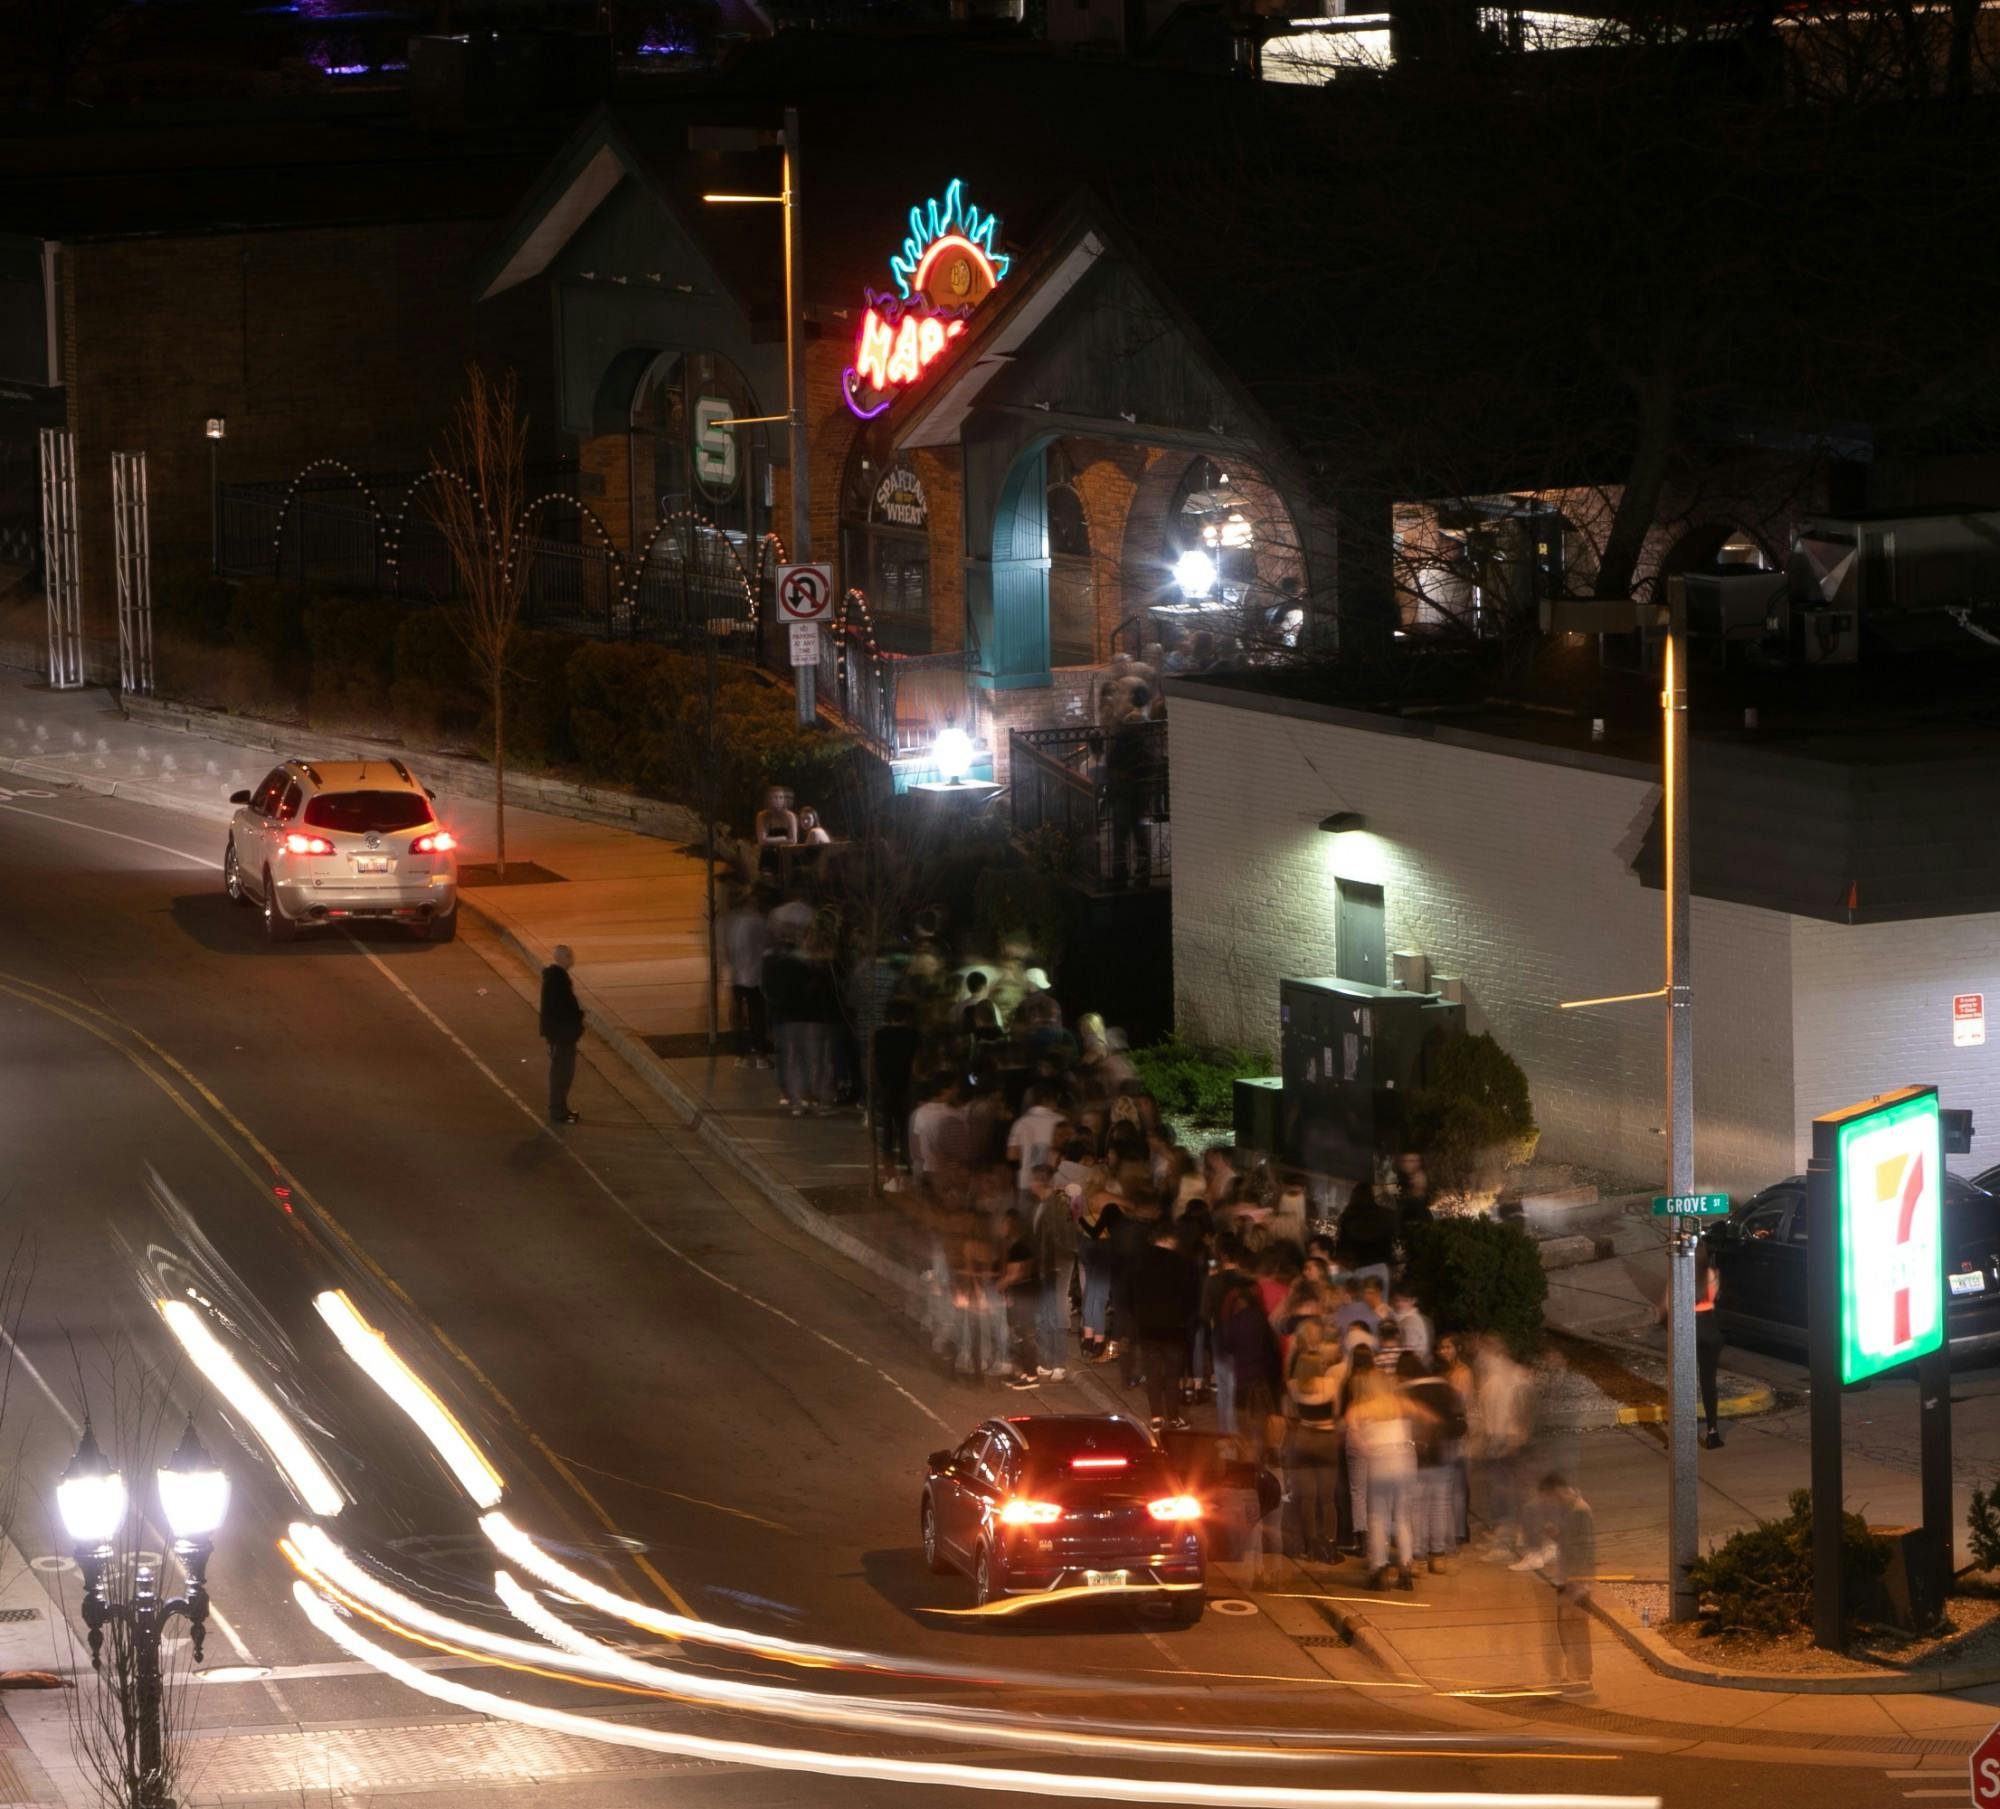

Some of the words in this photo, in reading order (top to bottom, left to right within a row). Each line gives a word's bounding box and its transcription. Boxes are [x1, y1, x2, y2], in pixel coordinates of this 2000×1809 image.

[695, 396, 736, 485] S
[886, 503, 922, 526] WHEAT
[1666, 1197, 1708, 1213] GROVE
[1713, 1198, 1721, 1207] ST
[1874, 1152, 1924, 1346] 7
